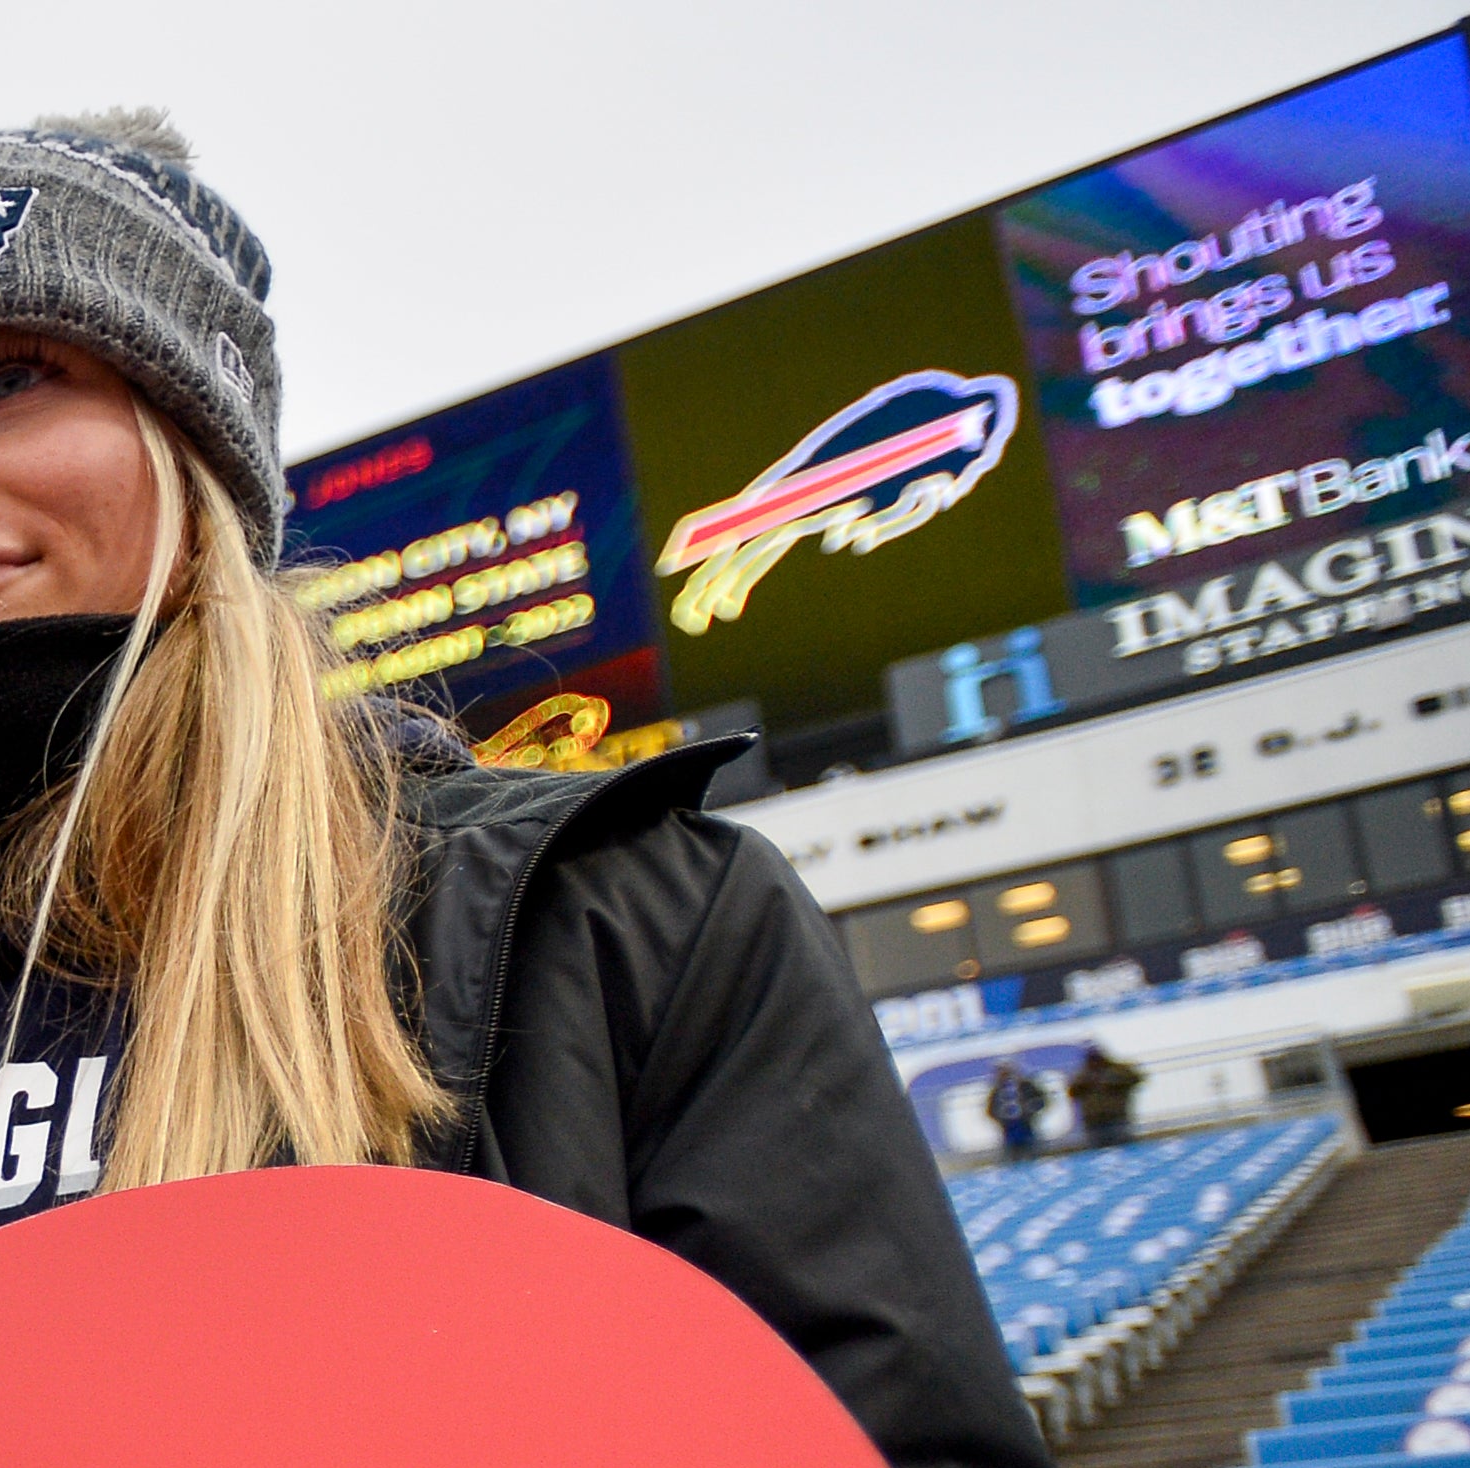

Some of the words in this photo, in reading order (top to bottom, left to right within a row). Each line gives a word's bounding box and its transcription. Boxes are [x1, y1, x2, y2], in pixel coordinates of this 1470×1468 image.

[1069, 174, 1384, 316] Shouting
[1077, 272, 1294, 375] brings
[1297, 238, 1397, 301] us
[505, 489, 579, 546] NY
[1104, 507, 1470, 659] IMAGIN
[1182, 569, 1470, 676] STAFFIN
